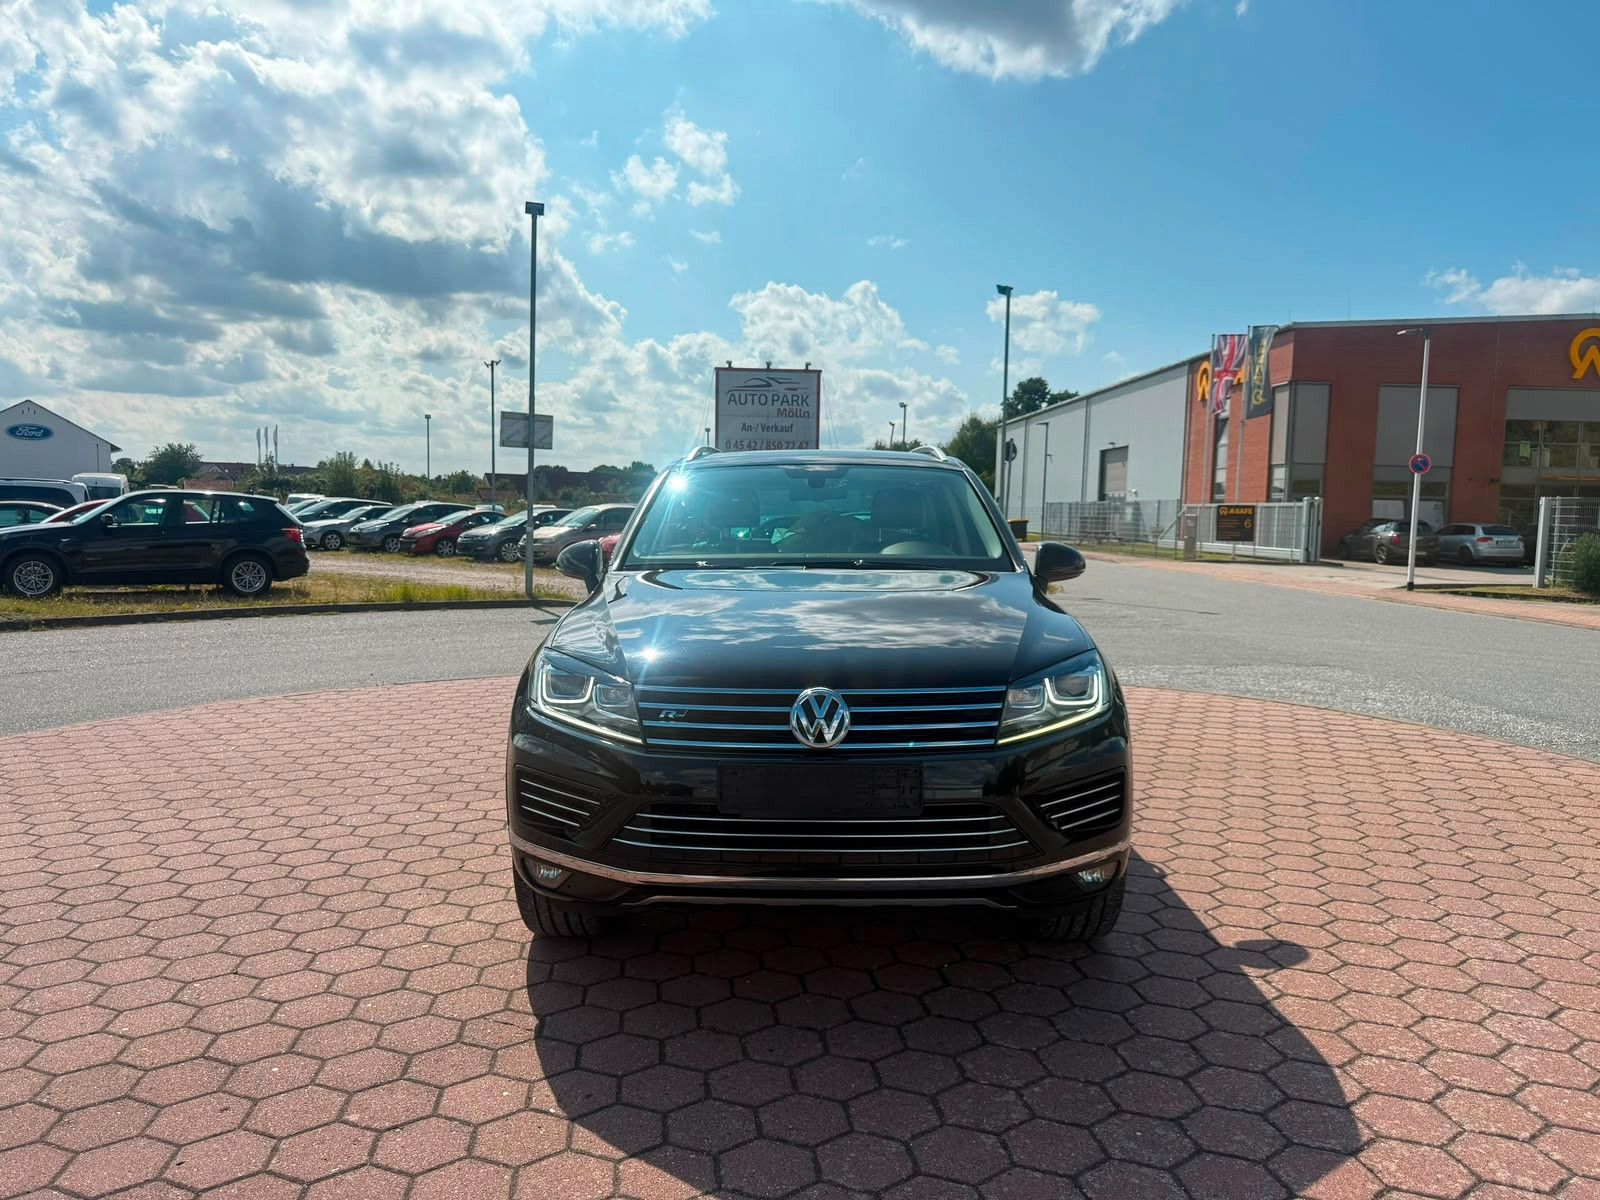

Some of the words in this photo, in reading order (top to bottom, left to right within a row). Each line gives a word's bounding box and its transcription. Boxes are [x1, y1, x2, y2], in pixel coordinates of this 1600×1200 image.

[727, 393, 768, 406] AUTO
[771, 394, 810, 407] PARK
[776, 407, 810, 418] Mölln
[16, 426, 44, 437] Ford
[760, 423, 794, 433] Verkauf
[725, 440, 732, 450] 0
[733, 440, 744, 450] 45
